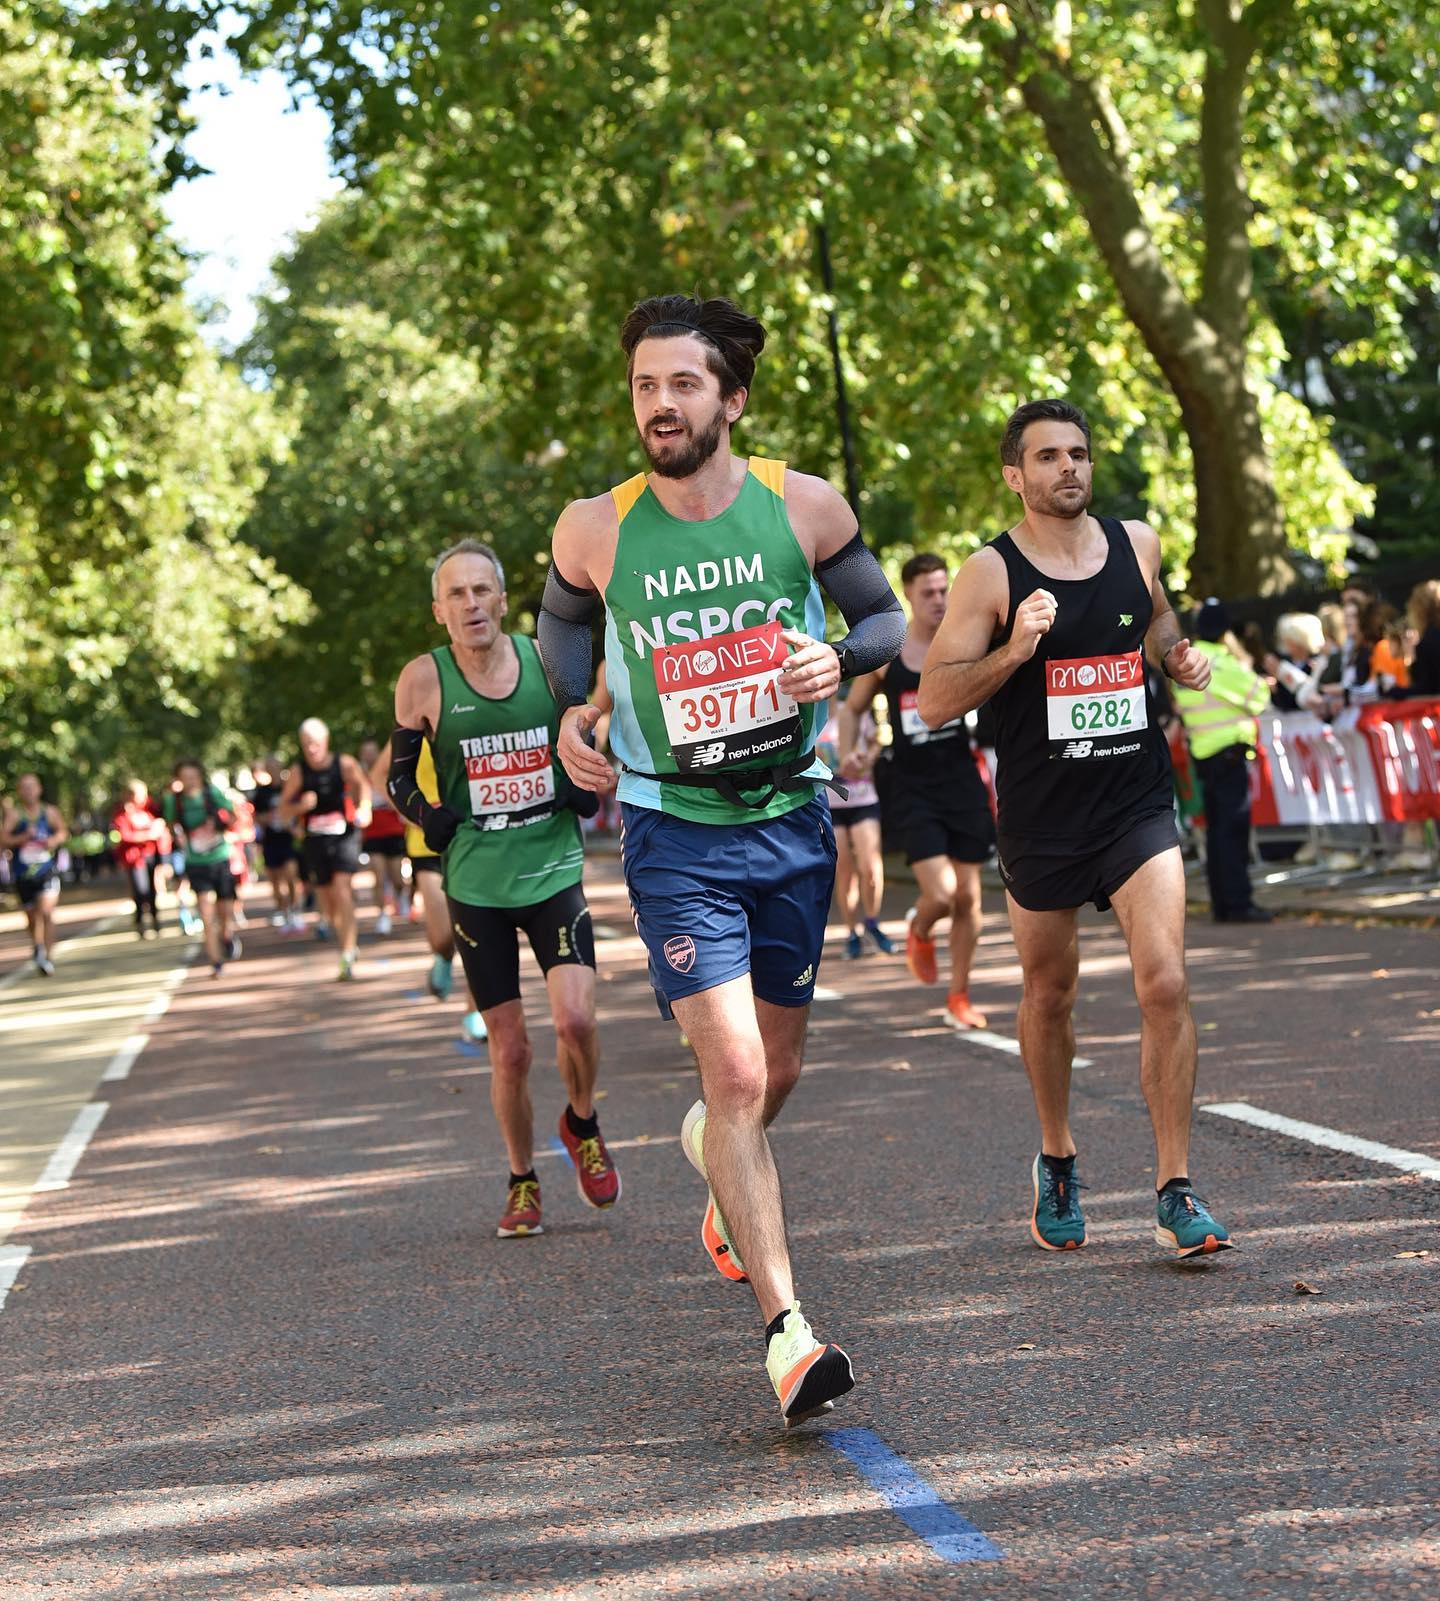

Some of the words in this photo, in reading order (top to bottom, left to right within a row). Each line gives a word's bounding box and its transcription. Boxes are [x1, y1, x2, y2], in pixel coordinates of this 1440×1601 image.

[644, 553, 764, 600] NADIM
[662, 633, 778, 682] MONEY
[694, 654, 715, 671] Virgin
[1052, 659, 1138, 688] MONEY
[680, 679, 780, 732] 39771
[1071, 698, 1132, 731] 6282
[459, 725, 549, 758] TRENTHAM
[728, 748, 750, 760] new
[751, 734, 793, 753] balance
[1093, 748, 1112, 757] new
[1113, 743, 1141, 756] balance
[470, 746, 548, 775] MONEY
[479, 776, 546, 806] 25836
[668, 940, 690, 952] Arsenal
